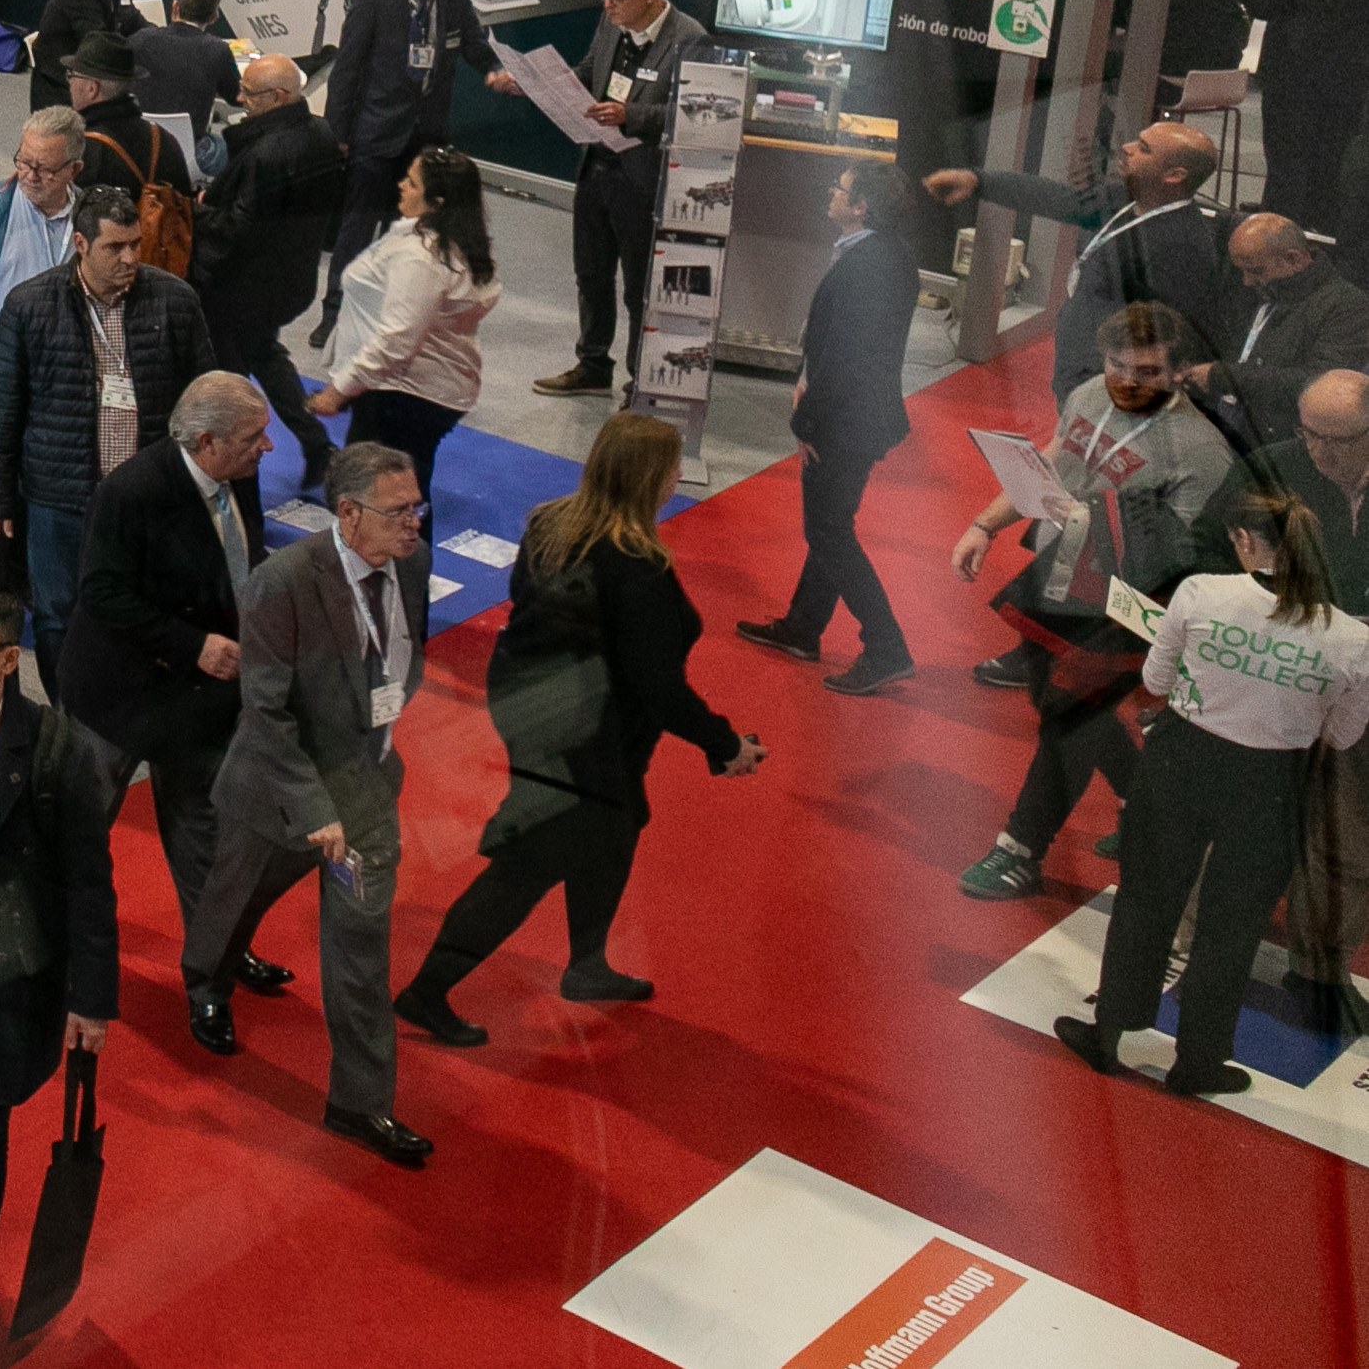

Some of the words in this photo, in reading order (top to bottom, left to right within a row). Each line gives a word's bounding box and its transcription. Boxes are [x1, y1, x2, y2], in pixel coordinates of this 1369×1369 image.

[246, 14, 288, 40] MES
[929, 21, 948, 36] de
[1197, 642, 1334, 695] COLLECT
[1209, 619, 1322, 670] TOUCH
[923, 1265, 995, 1316] Group
